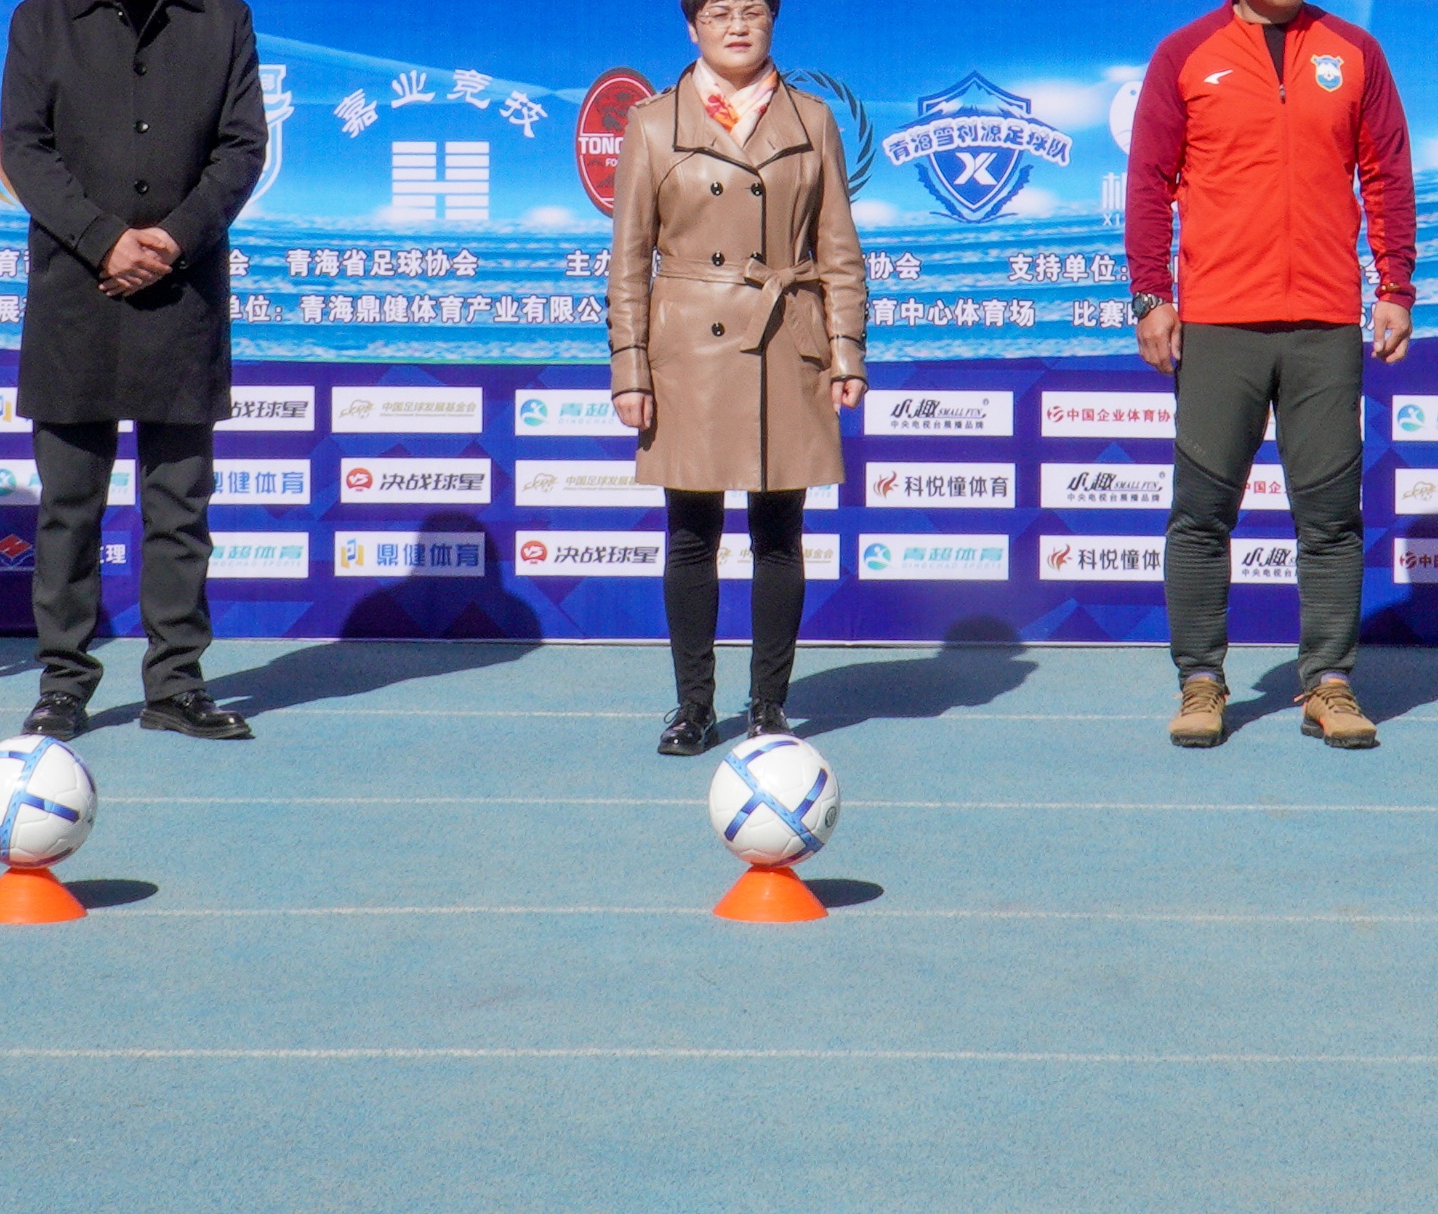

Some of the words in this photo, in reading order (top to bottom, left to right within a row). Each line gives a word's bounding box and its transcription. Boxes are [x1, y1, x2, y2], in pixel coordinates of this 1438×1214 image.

[333, 69, 548, 138] 嘉业竞技
[887, 124, 1069, 165] 青海雪利源足球队
[286, 249, 478, 277] 青海省足球协会
[861, 252, 922, 280] 协会
[864, 297, 1036, 327] 育中心体育场
[381, 402, 476, 413] 中国足球发展基金会
[558, 402, 617, 417] 青超
[1066, 408, 1171, 423] 中国企业体育协
[380, 473, 485, 491] 决战球星
[904, 476, 1009, 497] 科悦憧体育
[1245, 481, 1285, 495] 国企
[100, 544, 128, 564] 理
[376, 543, 479, 567] 鼎健体育
[554, 545, 660, 564] 决战球星
[903, 547, 1004, 561] 青超体育
